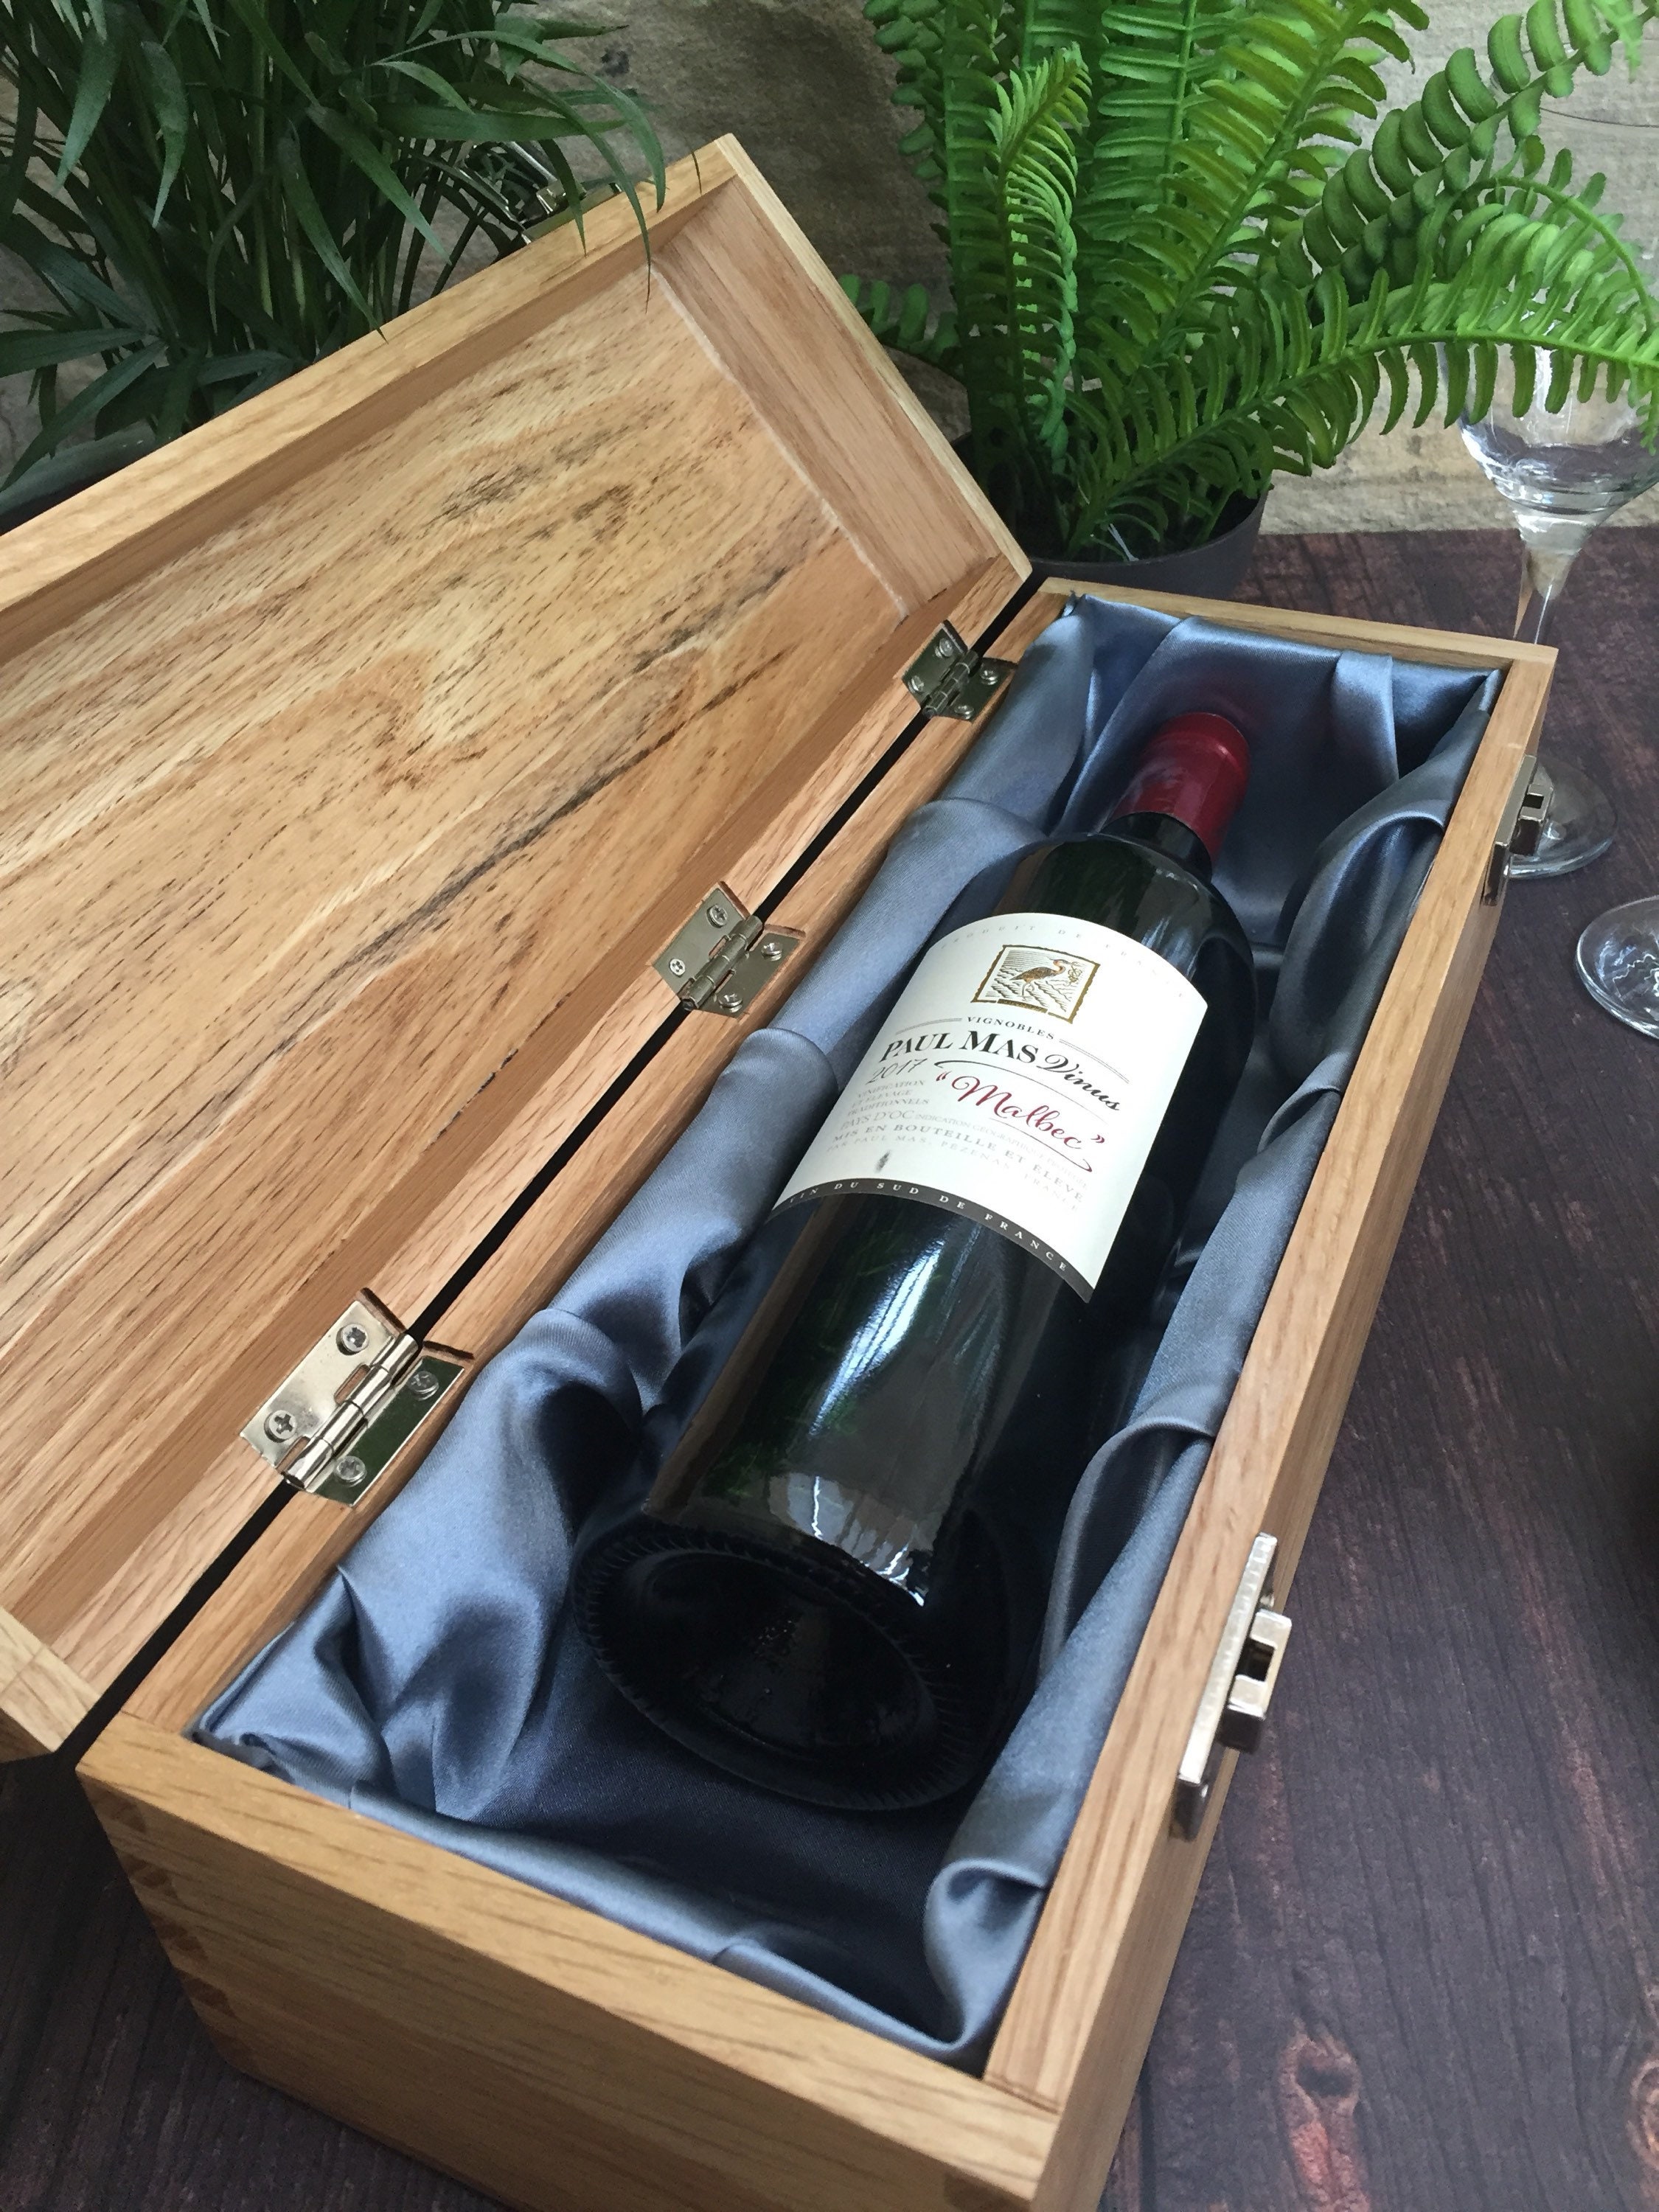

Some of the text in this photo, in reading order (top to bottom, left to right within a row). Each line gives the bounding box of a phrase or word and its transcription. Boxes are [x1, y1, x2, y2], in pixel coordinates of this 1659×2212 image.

[967, 1017, 1054, 1040] VIGNOBLES
[865, 1058, 928, 1085] 2017
[879, 1030, 1120, 1110] PAUL MAS Vinus
[832, 1130, 859, 1143] MIS
[865, 1124, 887, 1133] EN
[893, 1124, 997, 1151] BOUTEILLE
[1005, 1150, 1026, 1164] ET
[790, 1181, 1067, 1271] VIN DU SUD DE FRANCE
